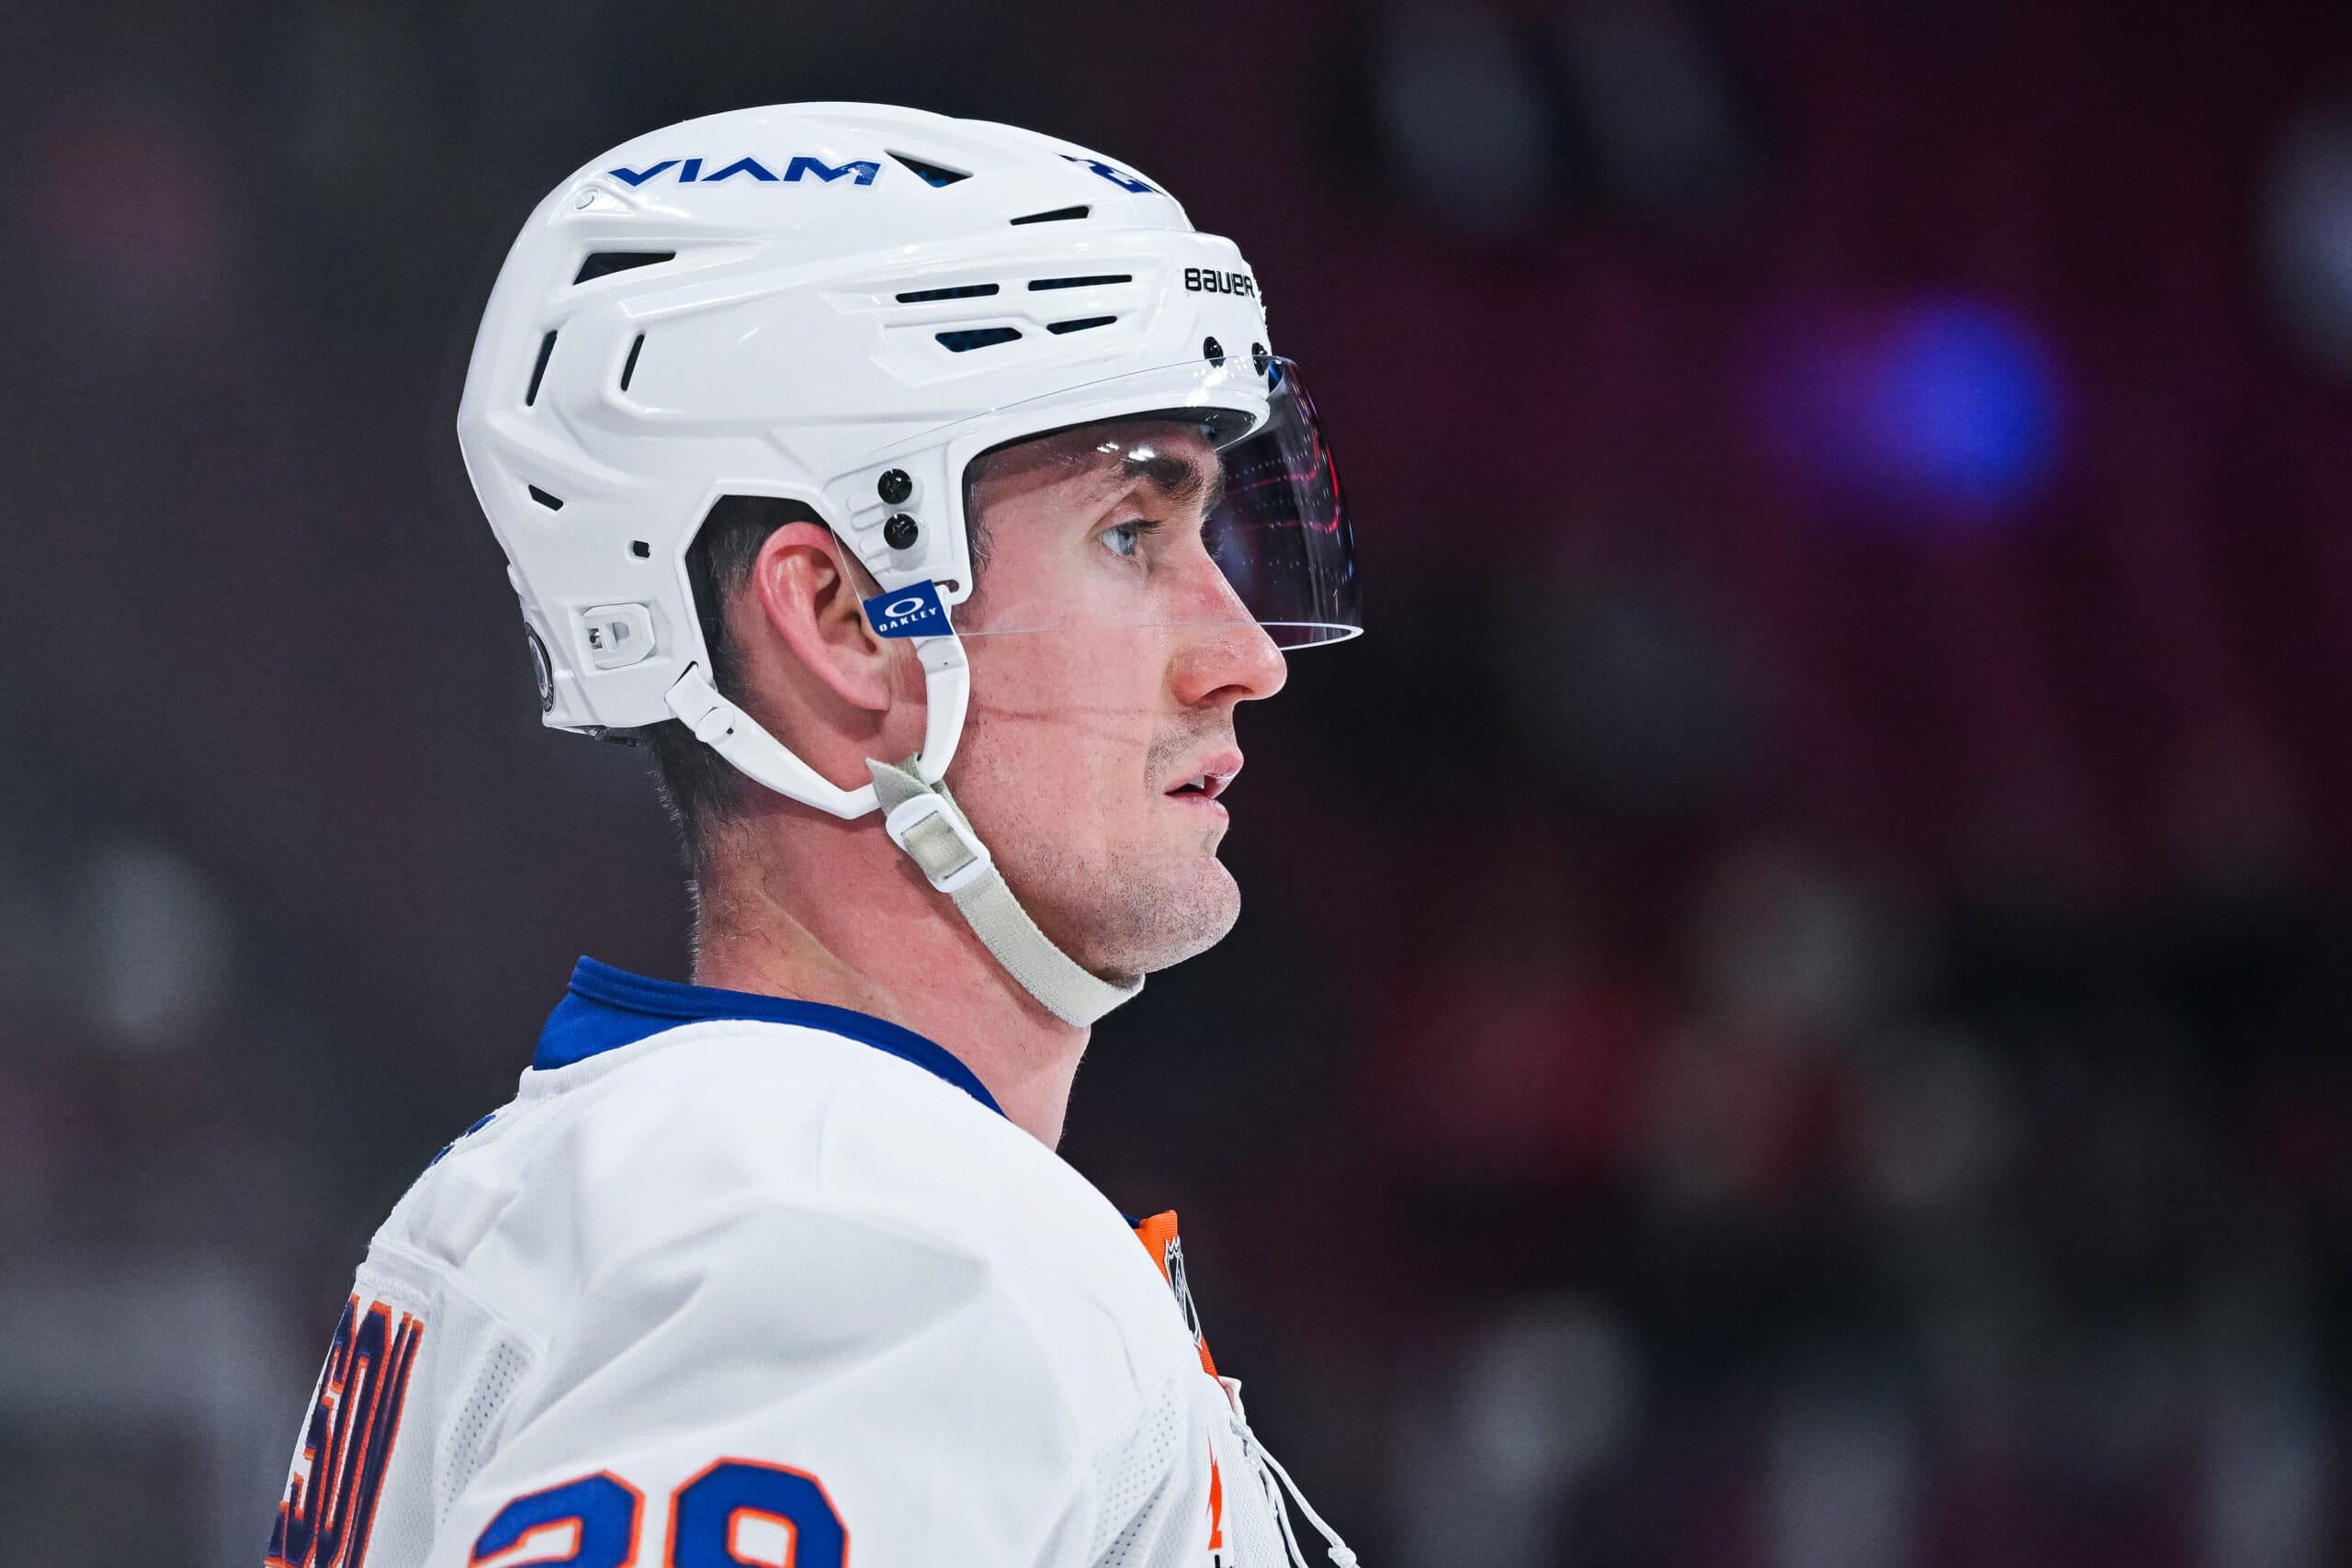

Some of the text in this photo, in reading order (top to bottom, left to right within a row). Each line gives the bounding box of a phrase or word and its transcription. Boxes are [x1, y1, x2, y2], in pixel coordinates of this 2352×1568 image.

[607, 156, 881, 187] VIAM
[879, 607, 937, 632] OAKLEY
[266, 1292, 424, 1568] SON
